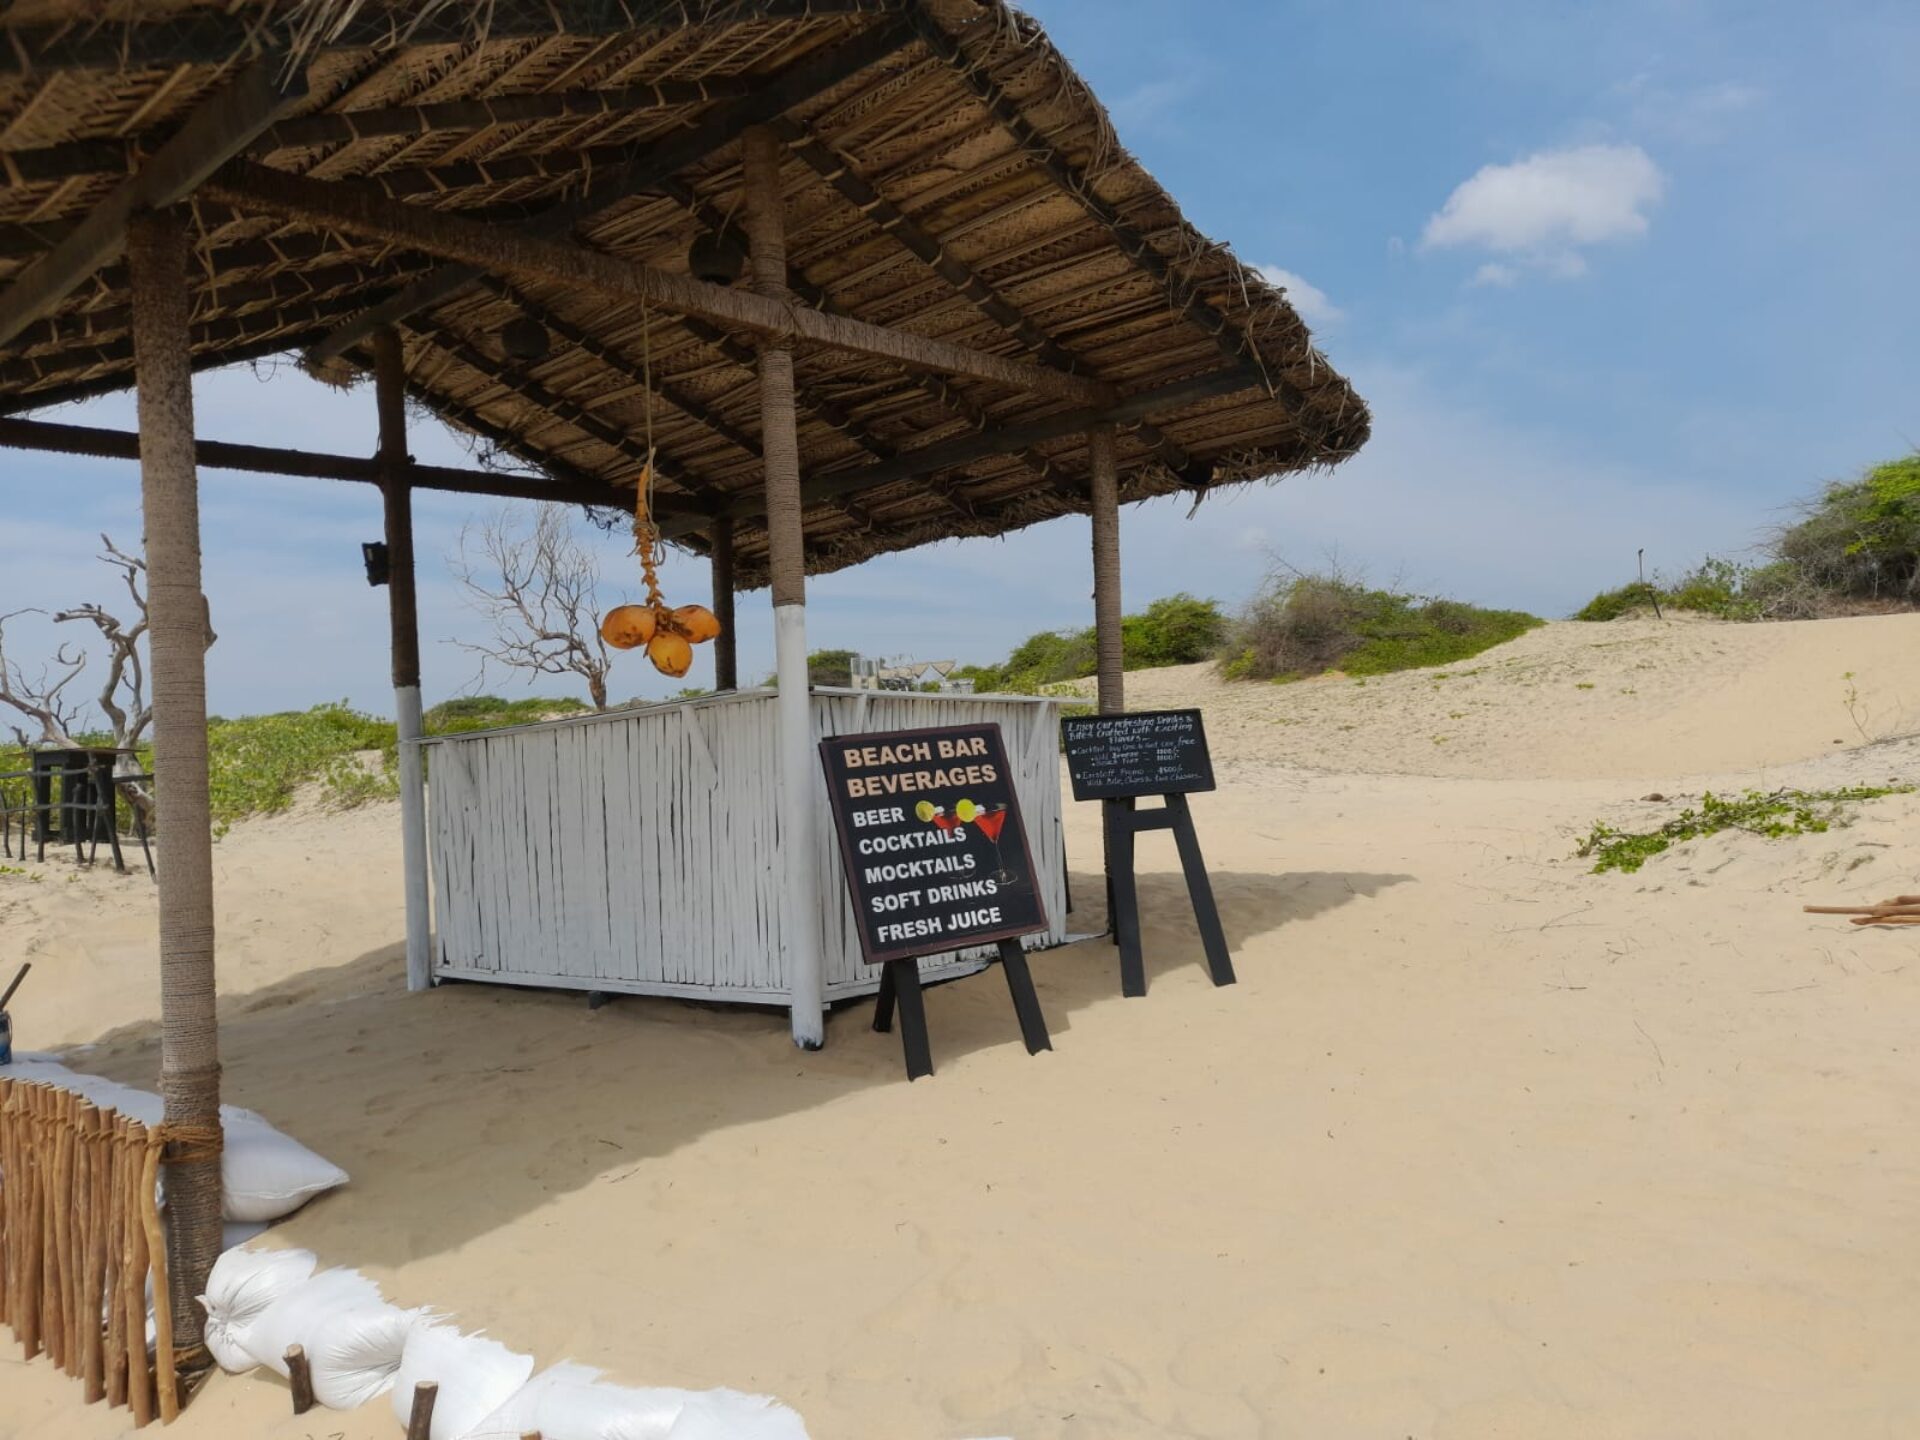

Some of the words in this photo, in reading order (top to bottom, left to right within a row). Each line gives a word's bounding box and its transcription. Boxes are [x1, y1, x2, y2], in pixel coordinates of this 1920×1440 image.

[843, 741, 932, 768] BEACH
[938, 737, 988, 759] BAR
[847, 764, 997, 798] BEVERAGES
[852, 807, 906, 827] BEER
[859, 826, 967, 855] COCKTAILS
[864, 853, 976, 884] MOCKTAILS
[871, 890, 922, 913] SOFT
[927, 879, 998, 905] DRINKS
[877, 917, 943, 943] FRESH
[947, 907, 1002, 931] JUICE
